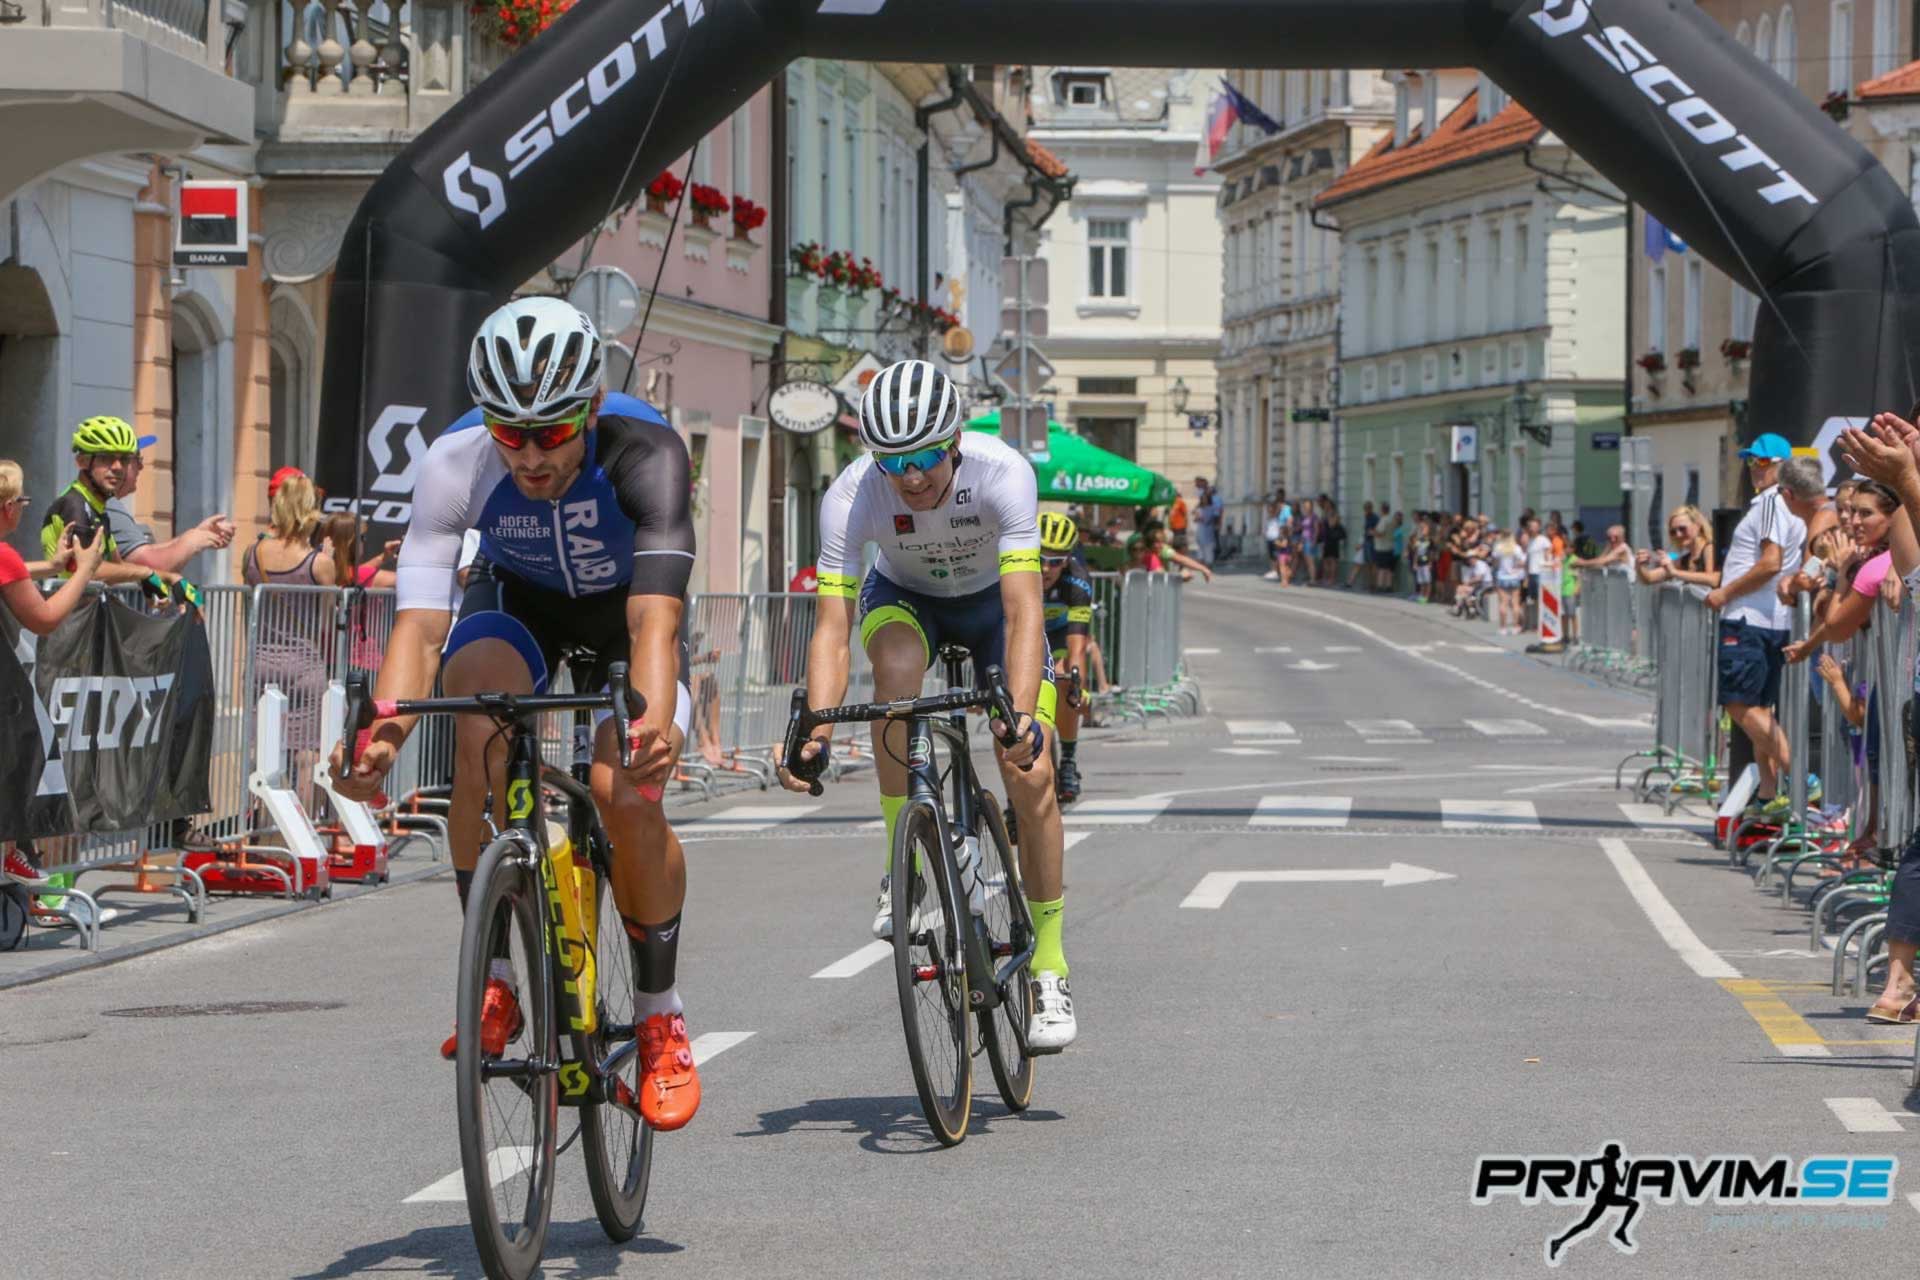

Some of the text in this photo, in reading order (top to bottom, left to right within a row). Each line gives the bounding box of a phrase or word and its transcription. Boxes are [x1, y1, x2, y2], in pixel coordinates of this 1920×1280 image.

[1582, 26, 1819, 204] SCOTT
[188, 254, 227, 263] BANKA
[323, 498, 413, 524] SCO
[499, 515, 538, 528] HOFER
[489, 526, 551, 539] LEITINGER
